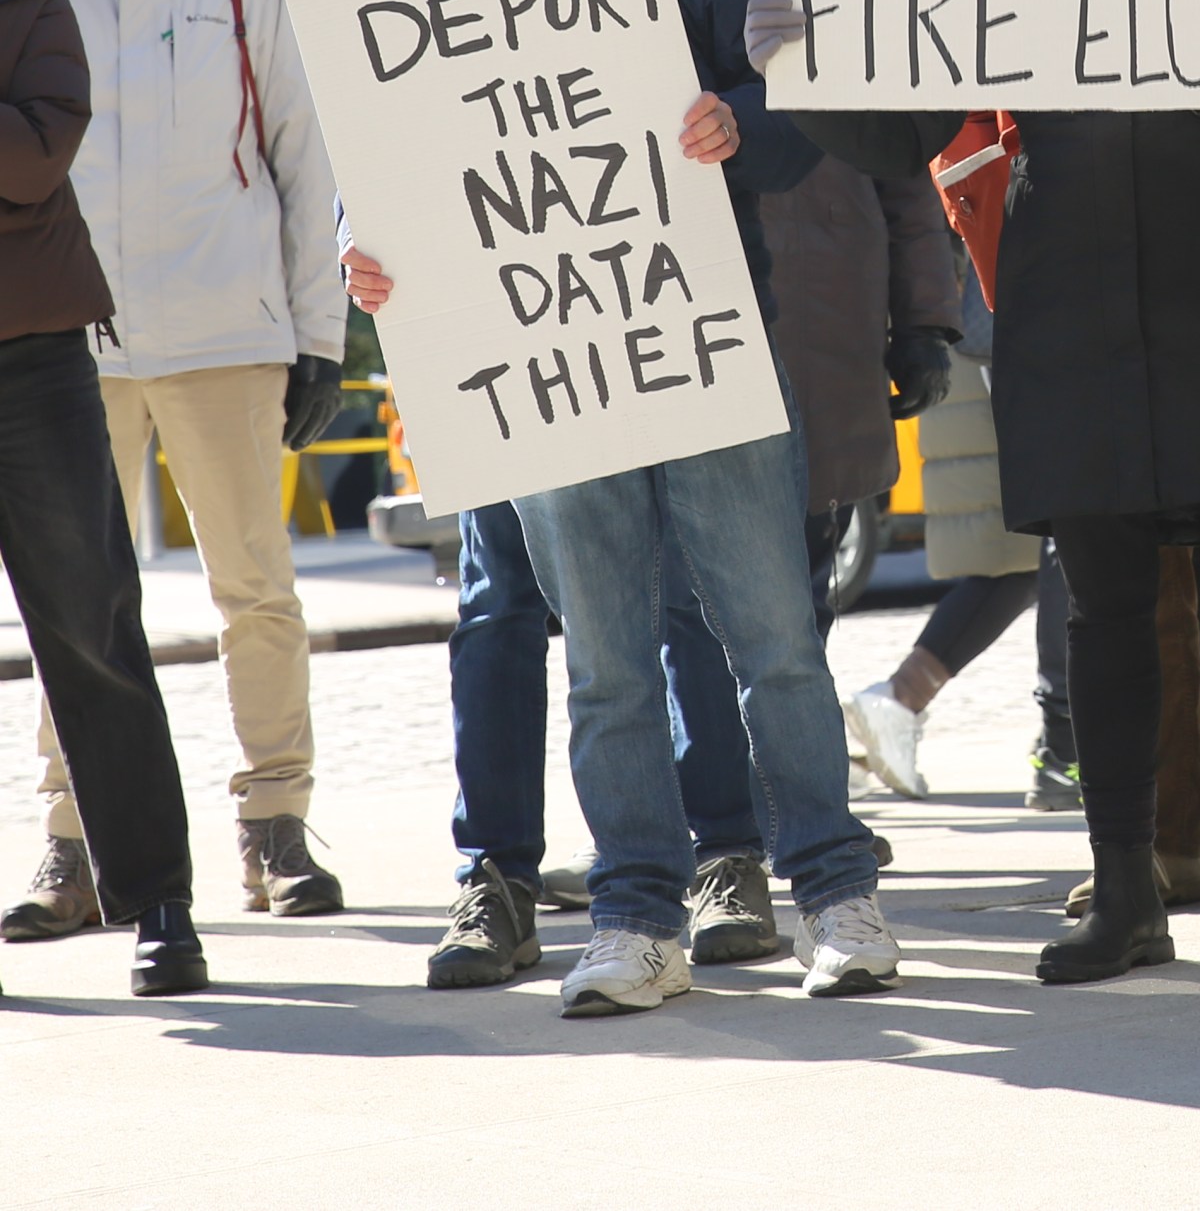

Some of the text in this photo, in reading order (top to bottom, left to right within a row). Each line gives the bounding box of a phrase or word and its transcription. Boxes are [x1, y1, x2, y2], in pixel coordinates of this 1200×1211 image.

[461, 68, 612, 138] THE
[462, 130, 672, 250] NAZI
[499, 241, 693, 327] DATA
[458, 308, 745, 440] THIEF
